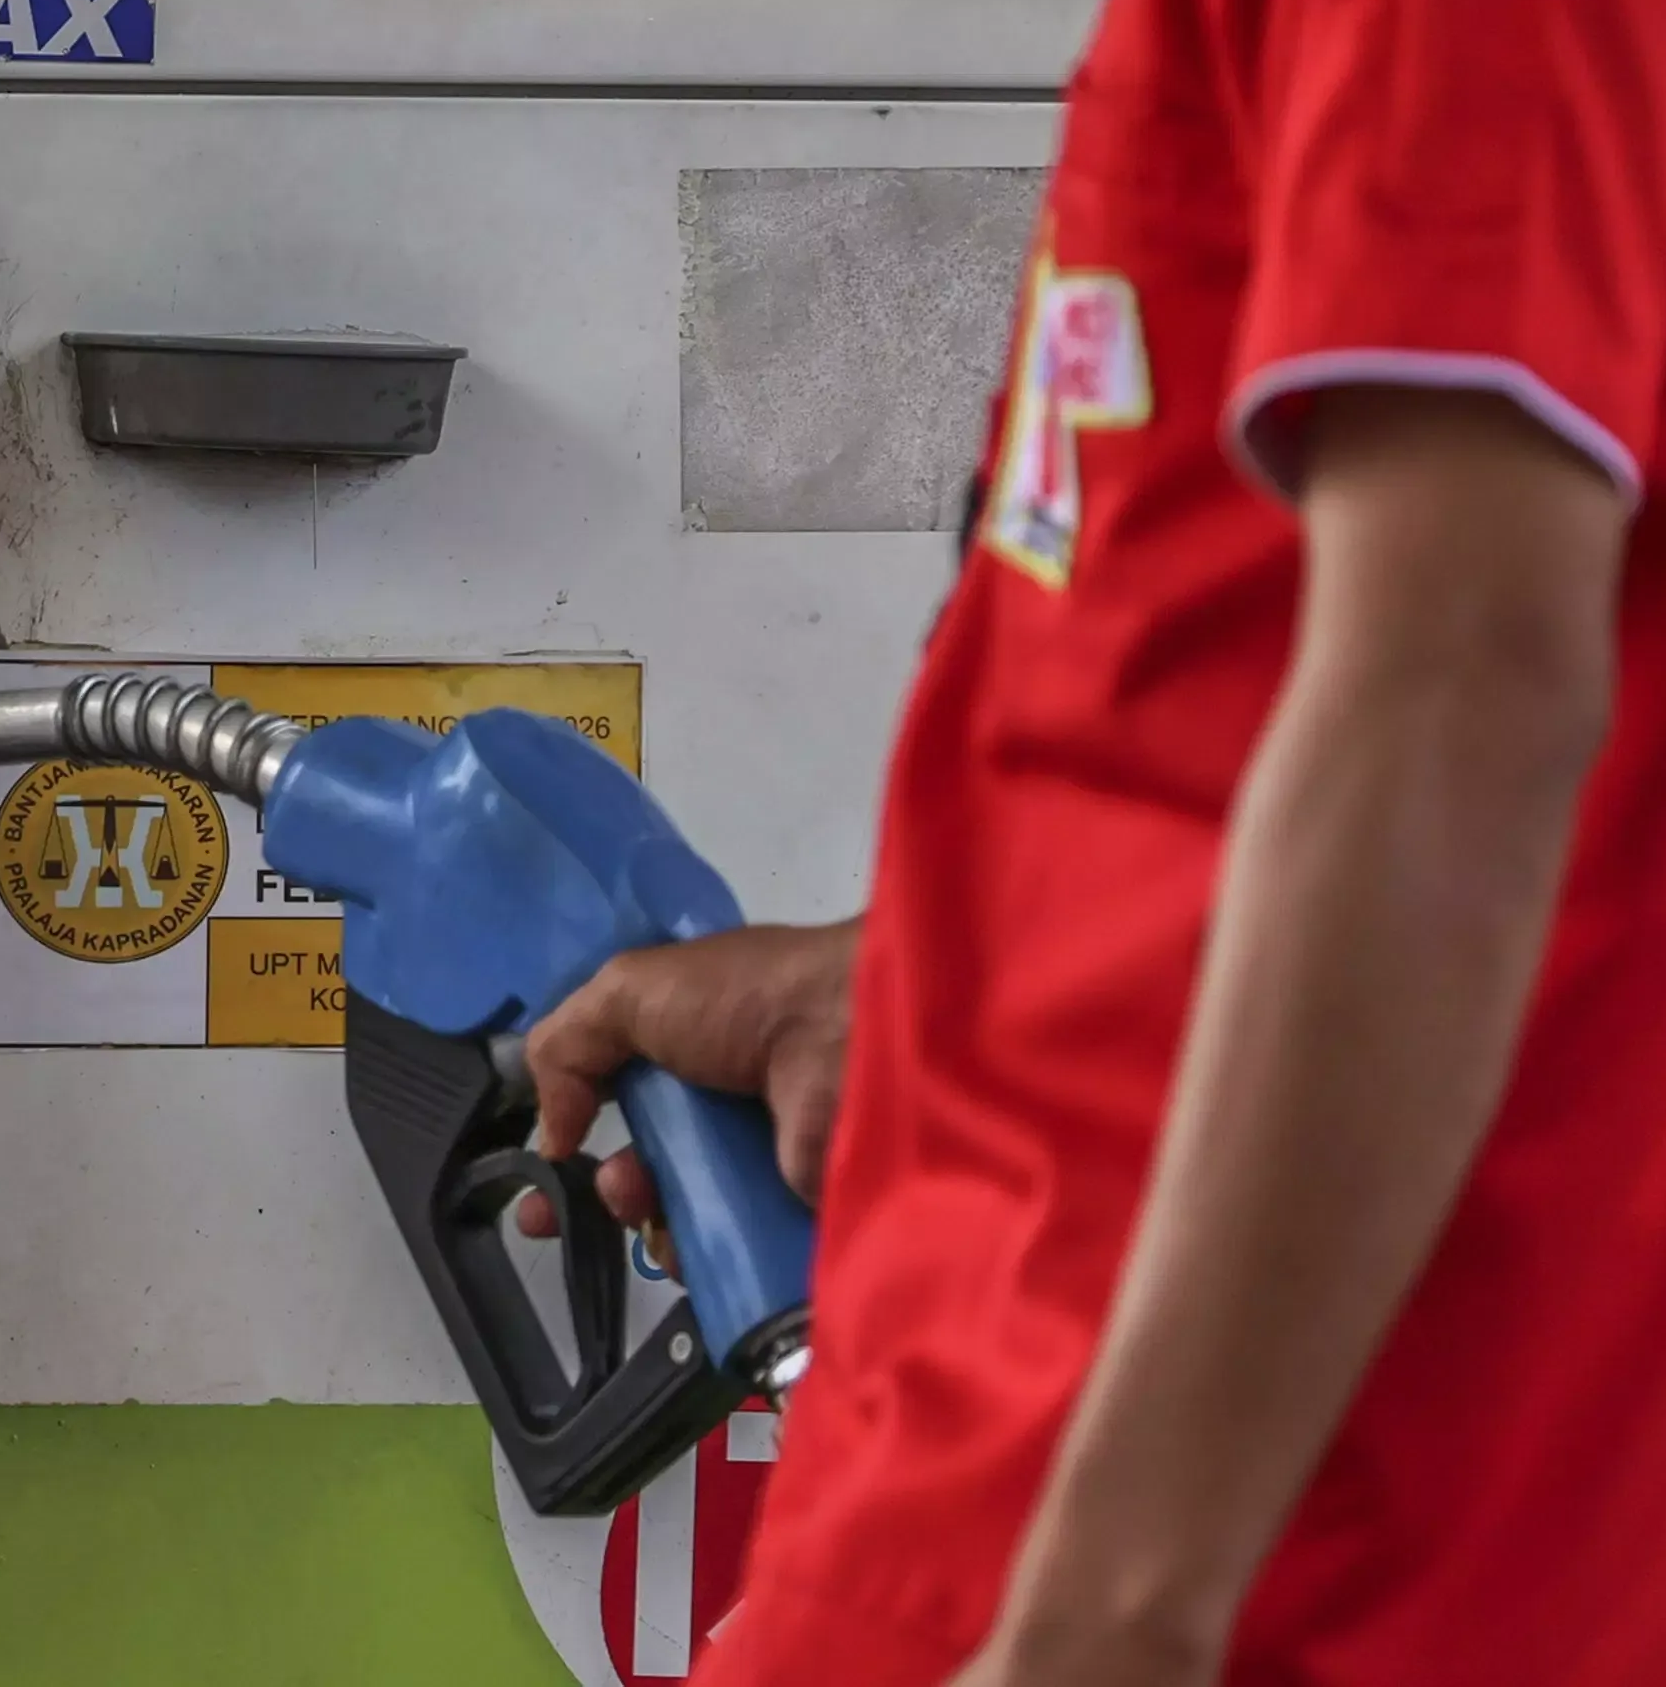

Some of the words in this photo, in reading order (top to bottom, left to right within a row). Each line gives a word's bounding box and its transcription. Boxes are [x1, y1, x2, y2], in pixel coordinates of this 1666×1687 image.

[4, 760, 90, 842] BANTJAN
[131, 766, 215, 843] AKARAN
[5, 863, 75, 945] PRALAJA
[83, 864, 214, 951] KAPRADANAN
[250, 954, 307, 975] UPT
